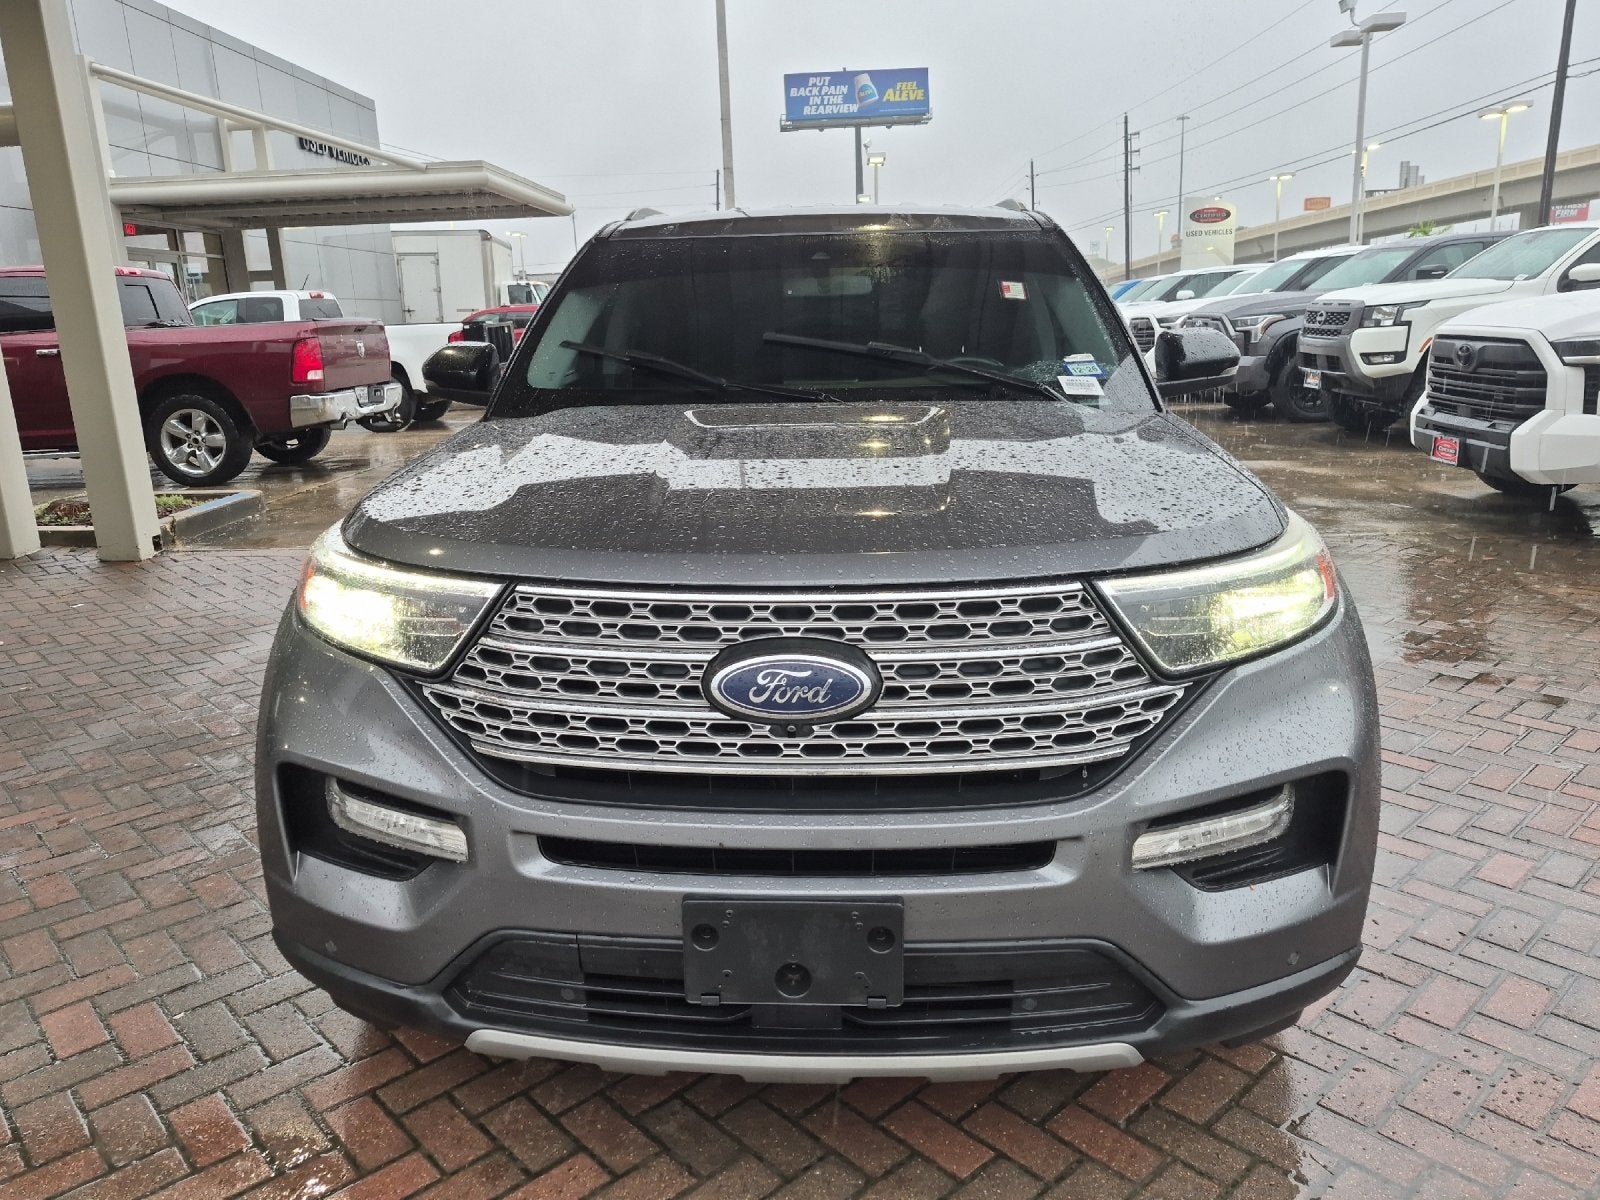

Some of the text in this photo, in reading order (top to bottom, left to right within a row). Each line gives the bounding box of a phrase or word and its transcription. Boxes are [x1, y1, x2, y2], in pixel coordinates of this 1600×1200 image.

[808, 76, 831, 87] PUT
[896, 81, 918, 90] FEEL
[790, 85, 848, 97] BACK PAIN
[883, 88, 925, 102] ALEVE
[809, 95, 844, 105] IN THE
[803, 103, 859, 115] REARVIEW
[1555, 208, 1578, 218] FIRM
[1185, 228, 1233, 238] USED VEHICLES
[748, 668, 833, 704] Ford
